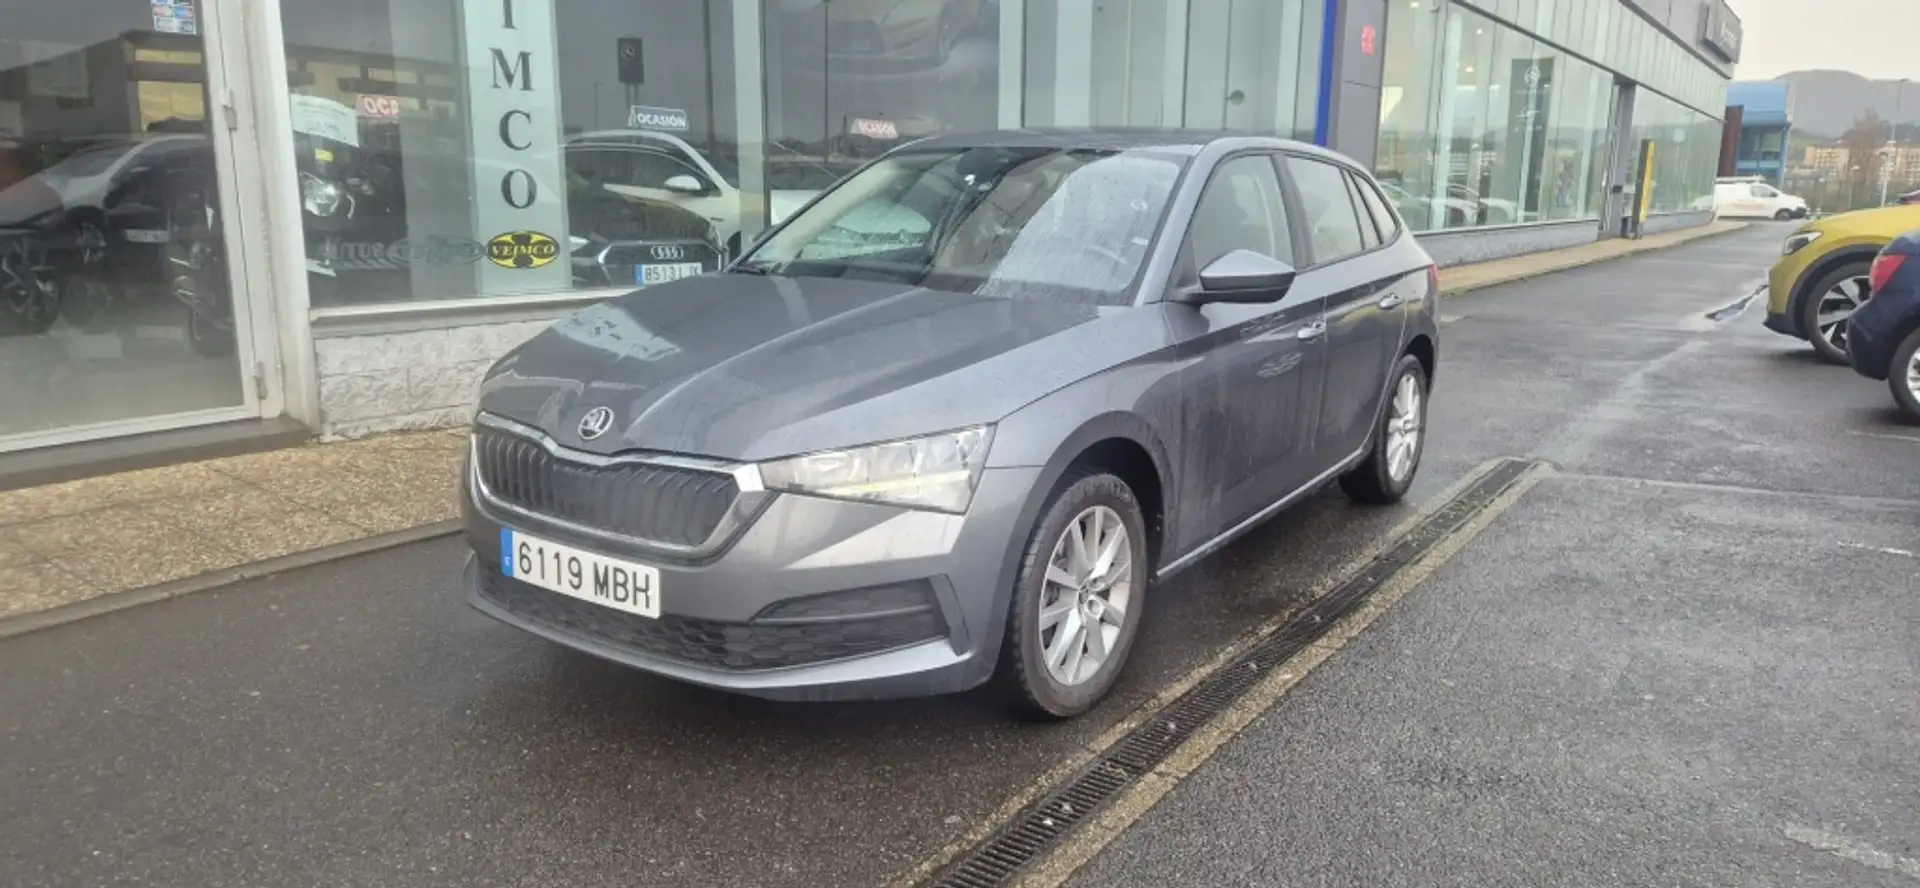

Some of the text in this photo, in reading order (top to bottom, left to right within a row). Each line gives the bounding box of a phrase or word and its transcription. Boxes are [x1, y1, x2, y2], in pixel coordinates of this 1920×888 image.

[492, 243, 556, 258] VEIMCO
[519, 541, 651, 610] 6119 MBH
